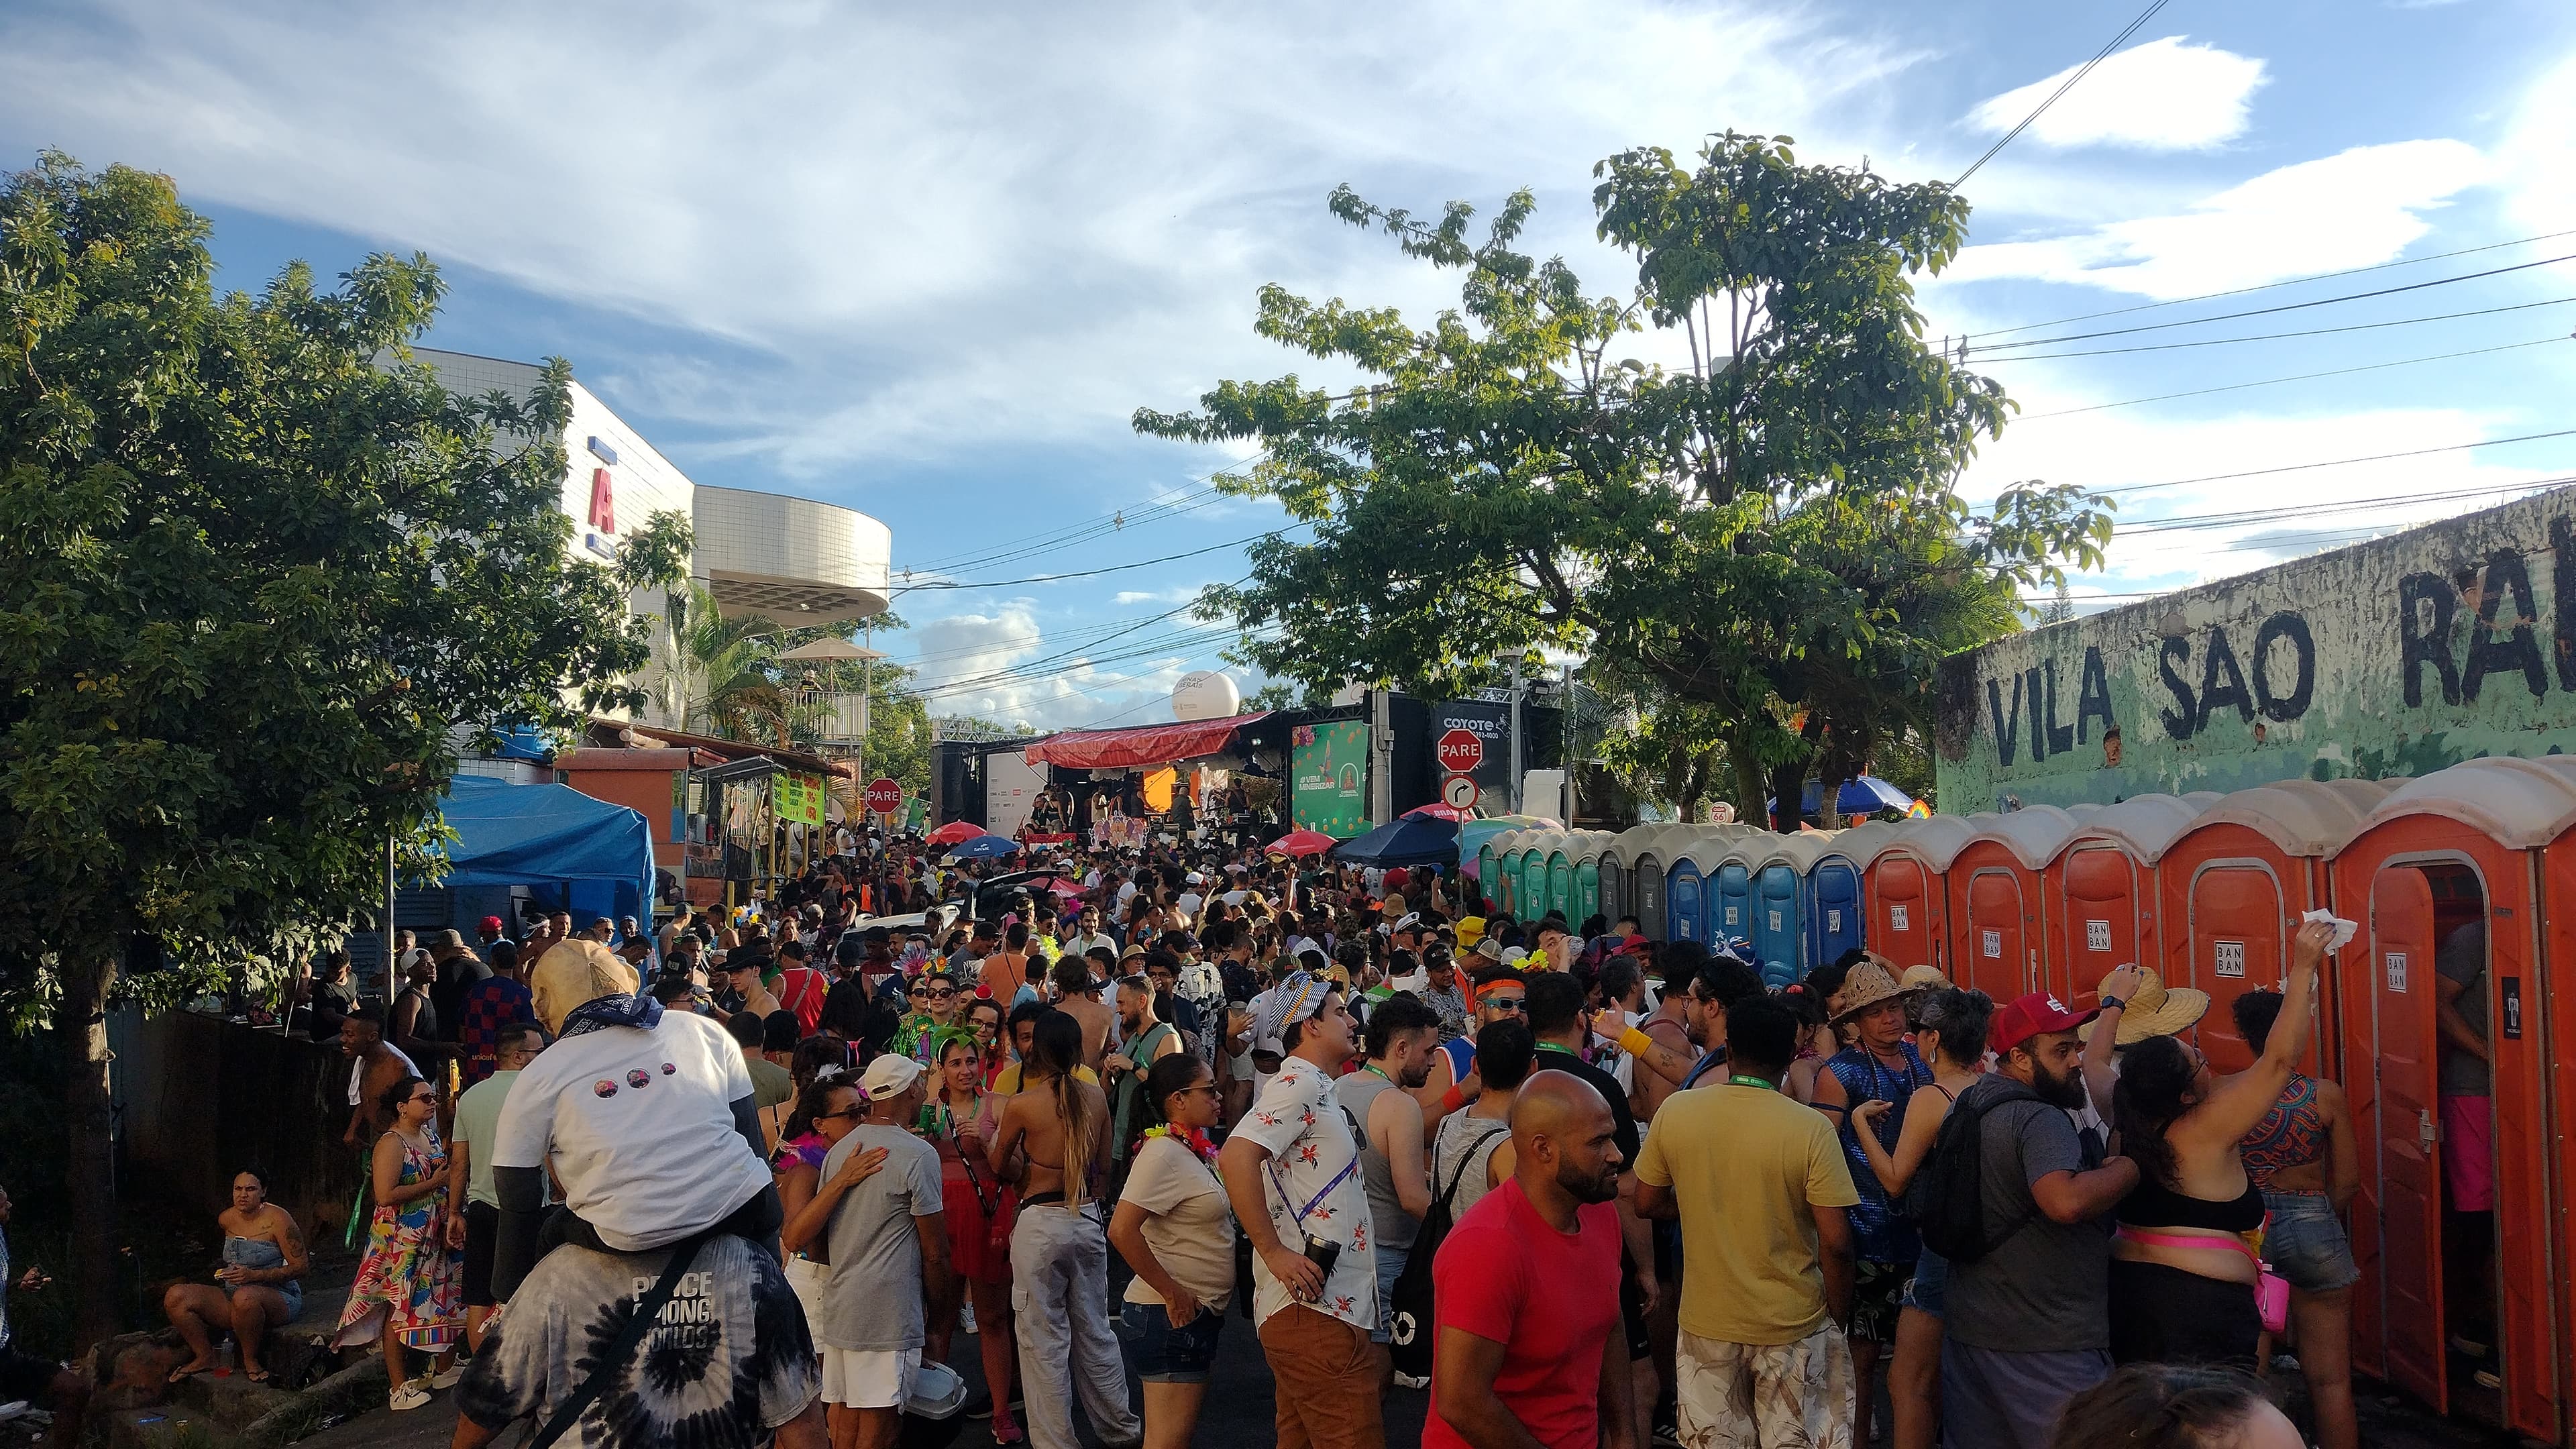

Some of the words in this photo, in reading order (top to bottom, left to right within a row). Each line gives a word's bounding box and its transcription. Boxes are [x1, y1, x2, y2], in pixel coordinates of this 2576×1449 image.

[1986, 646, 2113, 766] VILA
[1444, 717, 1495, 731] COYOTE
[1440, 744, 1480, 757] PARE
[867, 791, 900, 802] PARE
[1713, 813, 1724, 821] 66
[1892, 908, 1905, 918] BAN
[1893, 918, 1907, 928] BAN
[2088, 925, 2106, 934] BAN
[1984, 934, 1998, 944] BAN
[2090, 937, 2107, 947] BAN
[1986, 944, 1999, 955] BAN
[2217, 947, 2241, 959] BAN
[2218, 960, 2241, 972] BAN
[2388, 958, 2404, 971] BAN
[2390, 974, 2405, 986] BAN
